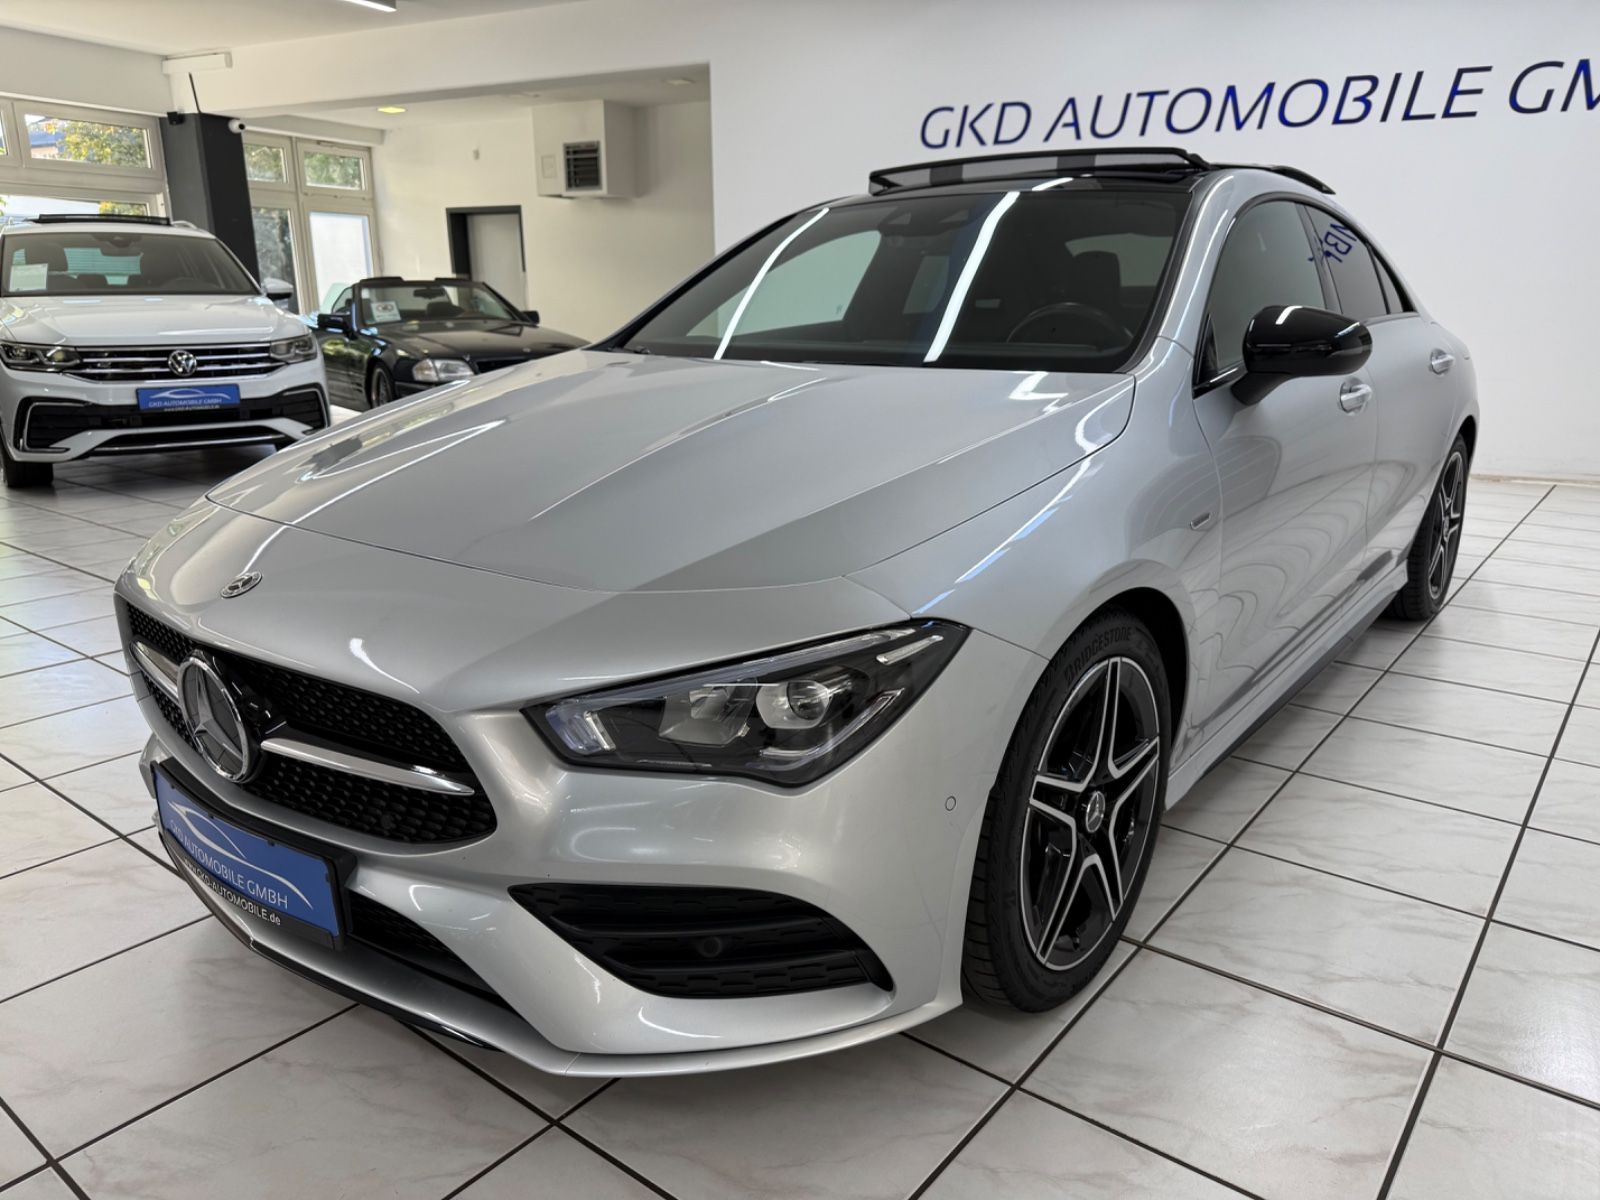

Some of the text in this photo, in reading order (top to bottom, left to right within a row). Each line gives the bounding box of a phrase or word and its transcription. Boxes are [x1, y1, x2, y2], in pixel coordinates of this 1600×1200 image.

[920, 101, 1032, 149] GKD
[1043, 65, 1493, 143] AUTOMOBILE
[1063, 626, 1132, 686] BRIDGESTONE
[184, 835, 245, 889] AUTOMOBILE
[246, 879, 288, 910] GMBH
